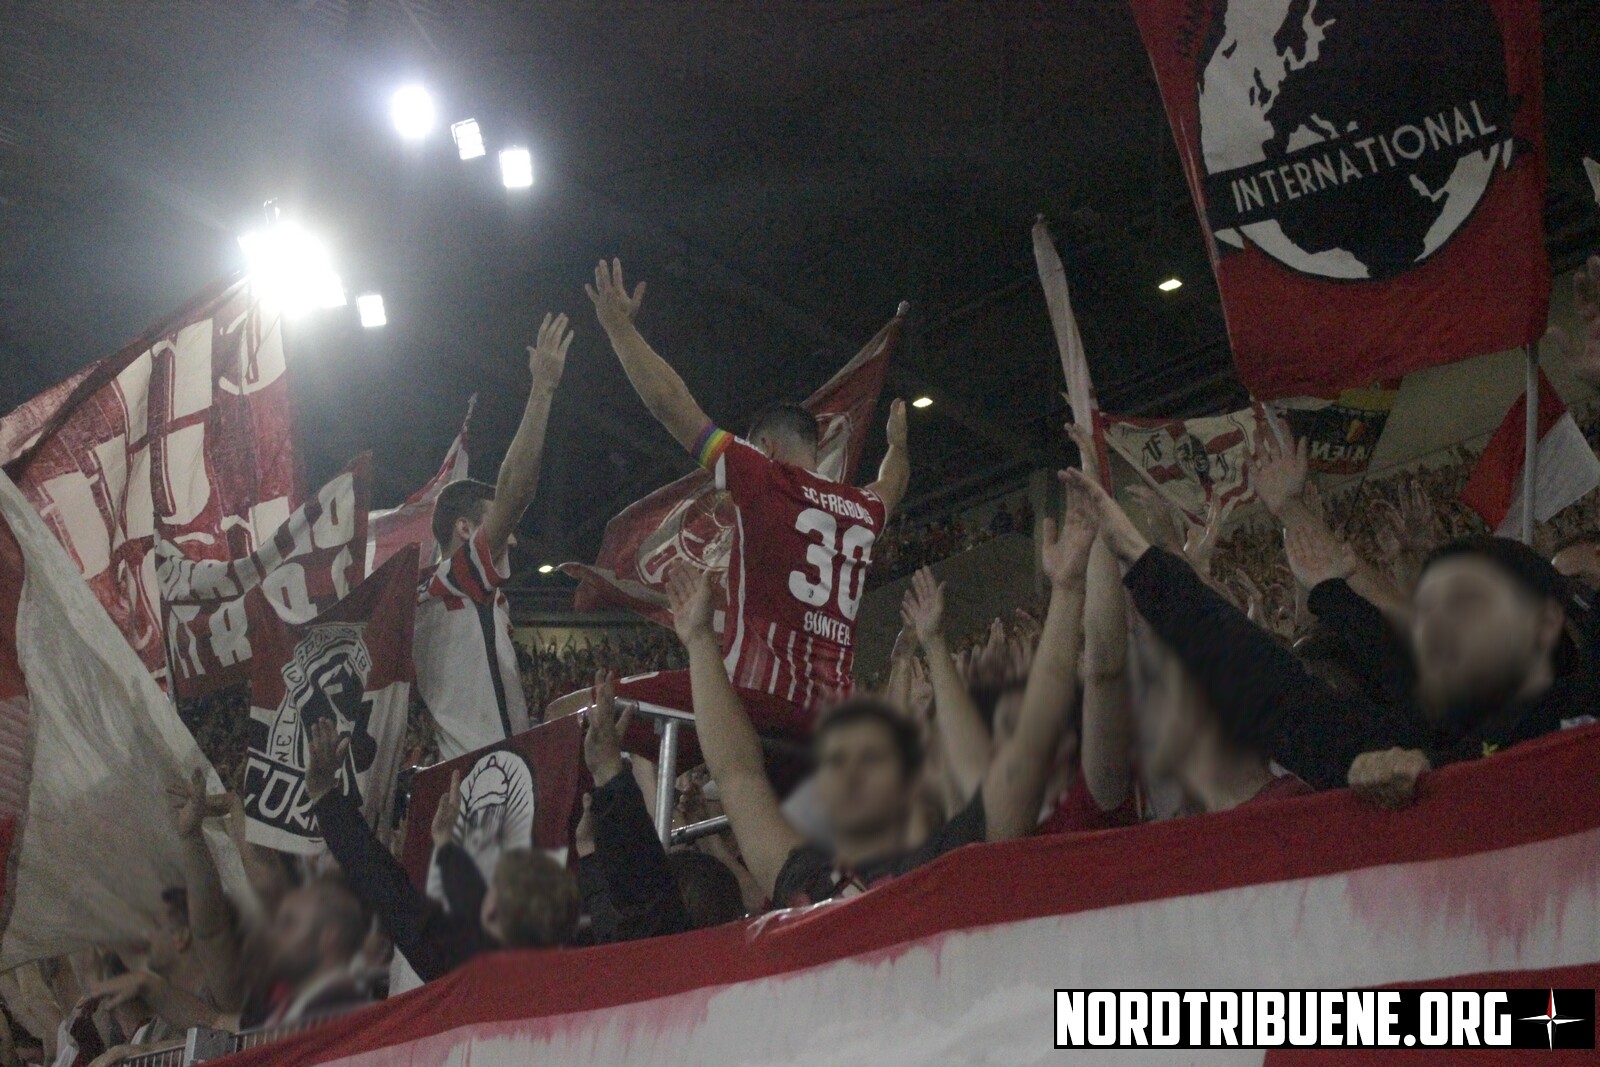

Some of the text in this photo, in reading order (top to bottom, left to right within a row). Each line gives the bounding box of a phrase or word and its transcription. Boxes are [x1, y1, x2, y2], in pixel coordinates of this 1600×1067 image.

[1231, 101, 1497, 214] INTERNATIONAL
[788, 507, 876, 622] 30
[803, 610, 852, 647] GÜNTER
